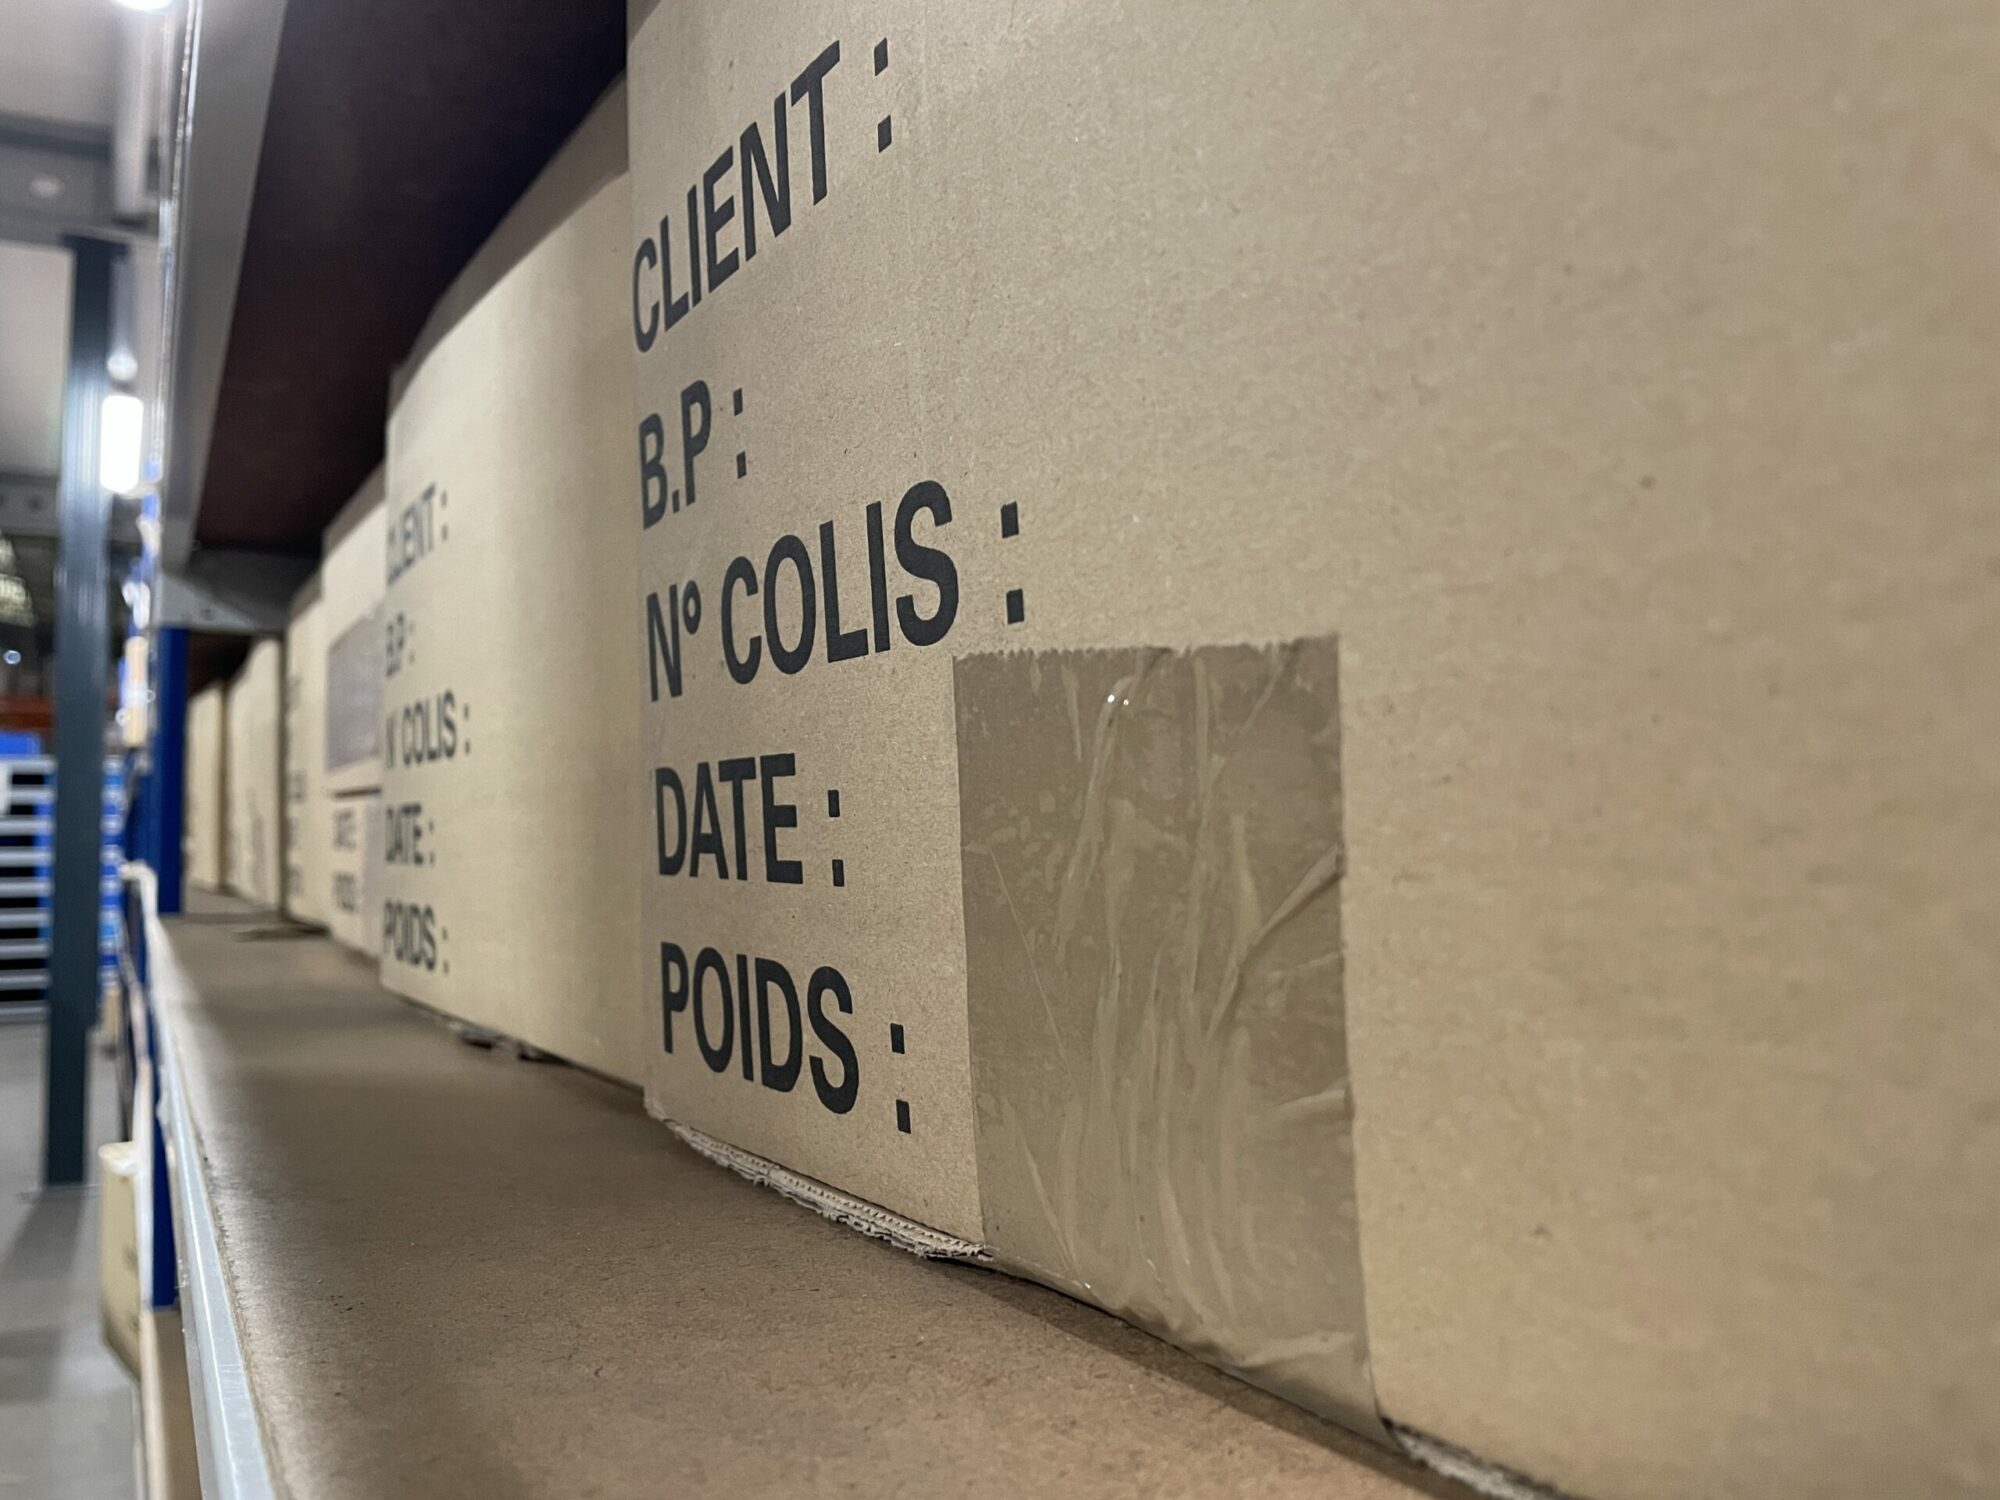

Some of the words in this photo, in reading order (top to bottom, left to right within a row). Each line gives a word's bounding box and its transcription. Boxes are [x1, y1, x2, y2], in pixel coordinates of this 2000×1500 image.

[632, 39, 841, 353] CLIENT
[638, 379, 712, 531] B.P
[720, 480, 959, 685] COLIS
[654, 752, 804, 885] DATE
[660, 940, 860, 1115] POIDS
